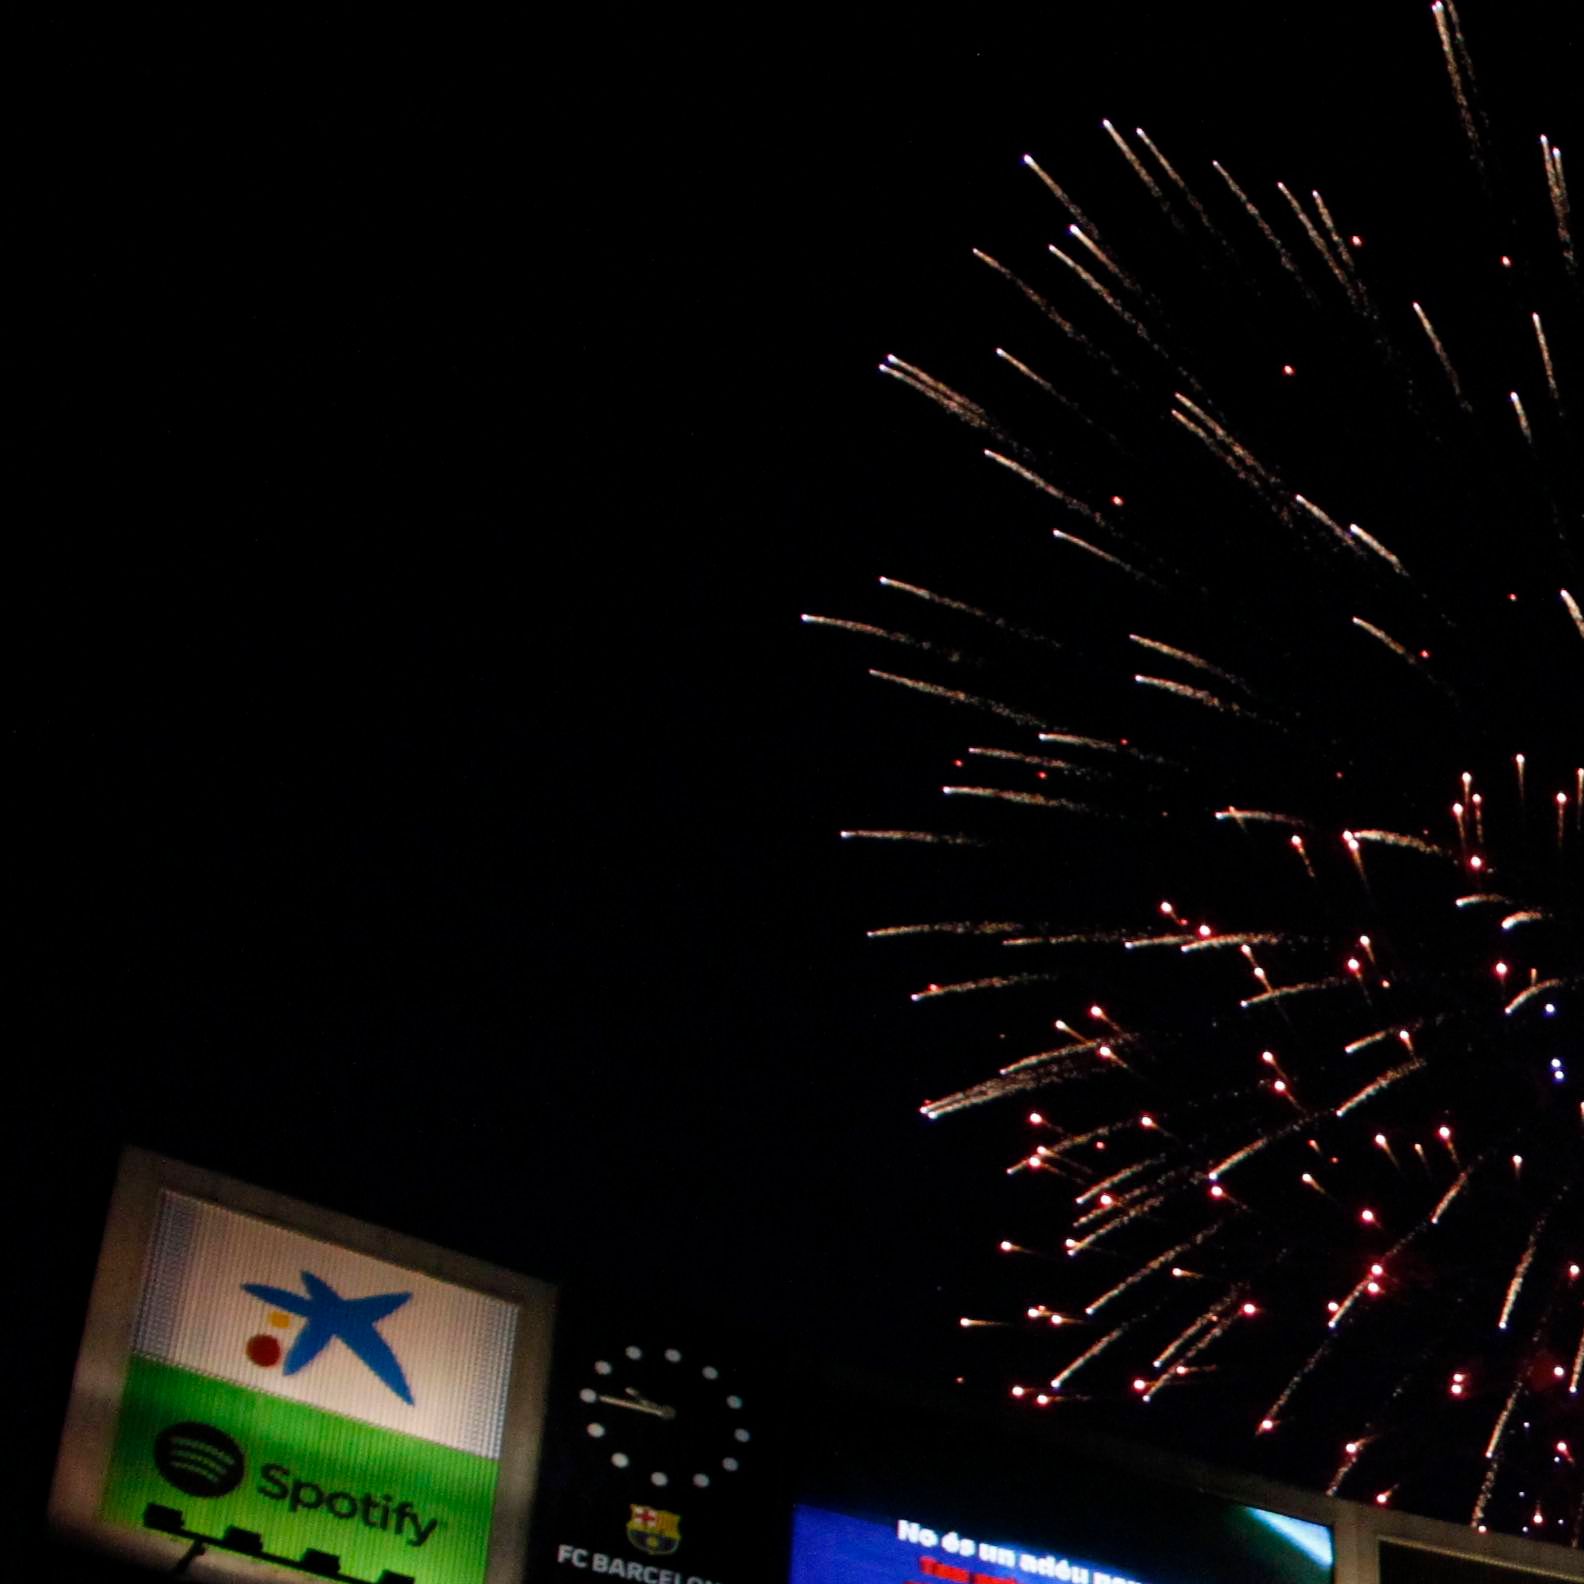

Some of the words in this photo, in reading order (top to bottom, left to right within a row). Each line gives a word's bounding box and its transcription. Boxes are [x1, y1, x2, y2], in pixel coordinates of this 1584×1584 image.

[257, 1462, 438, 1548] Spotify
[557, 1543, 588, 1571] FC
[898, 1519, 938, 1548] No
[941, 1531, 975, 1557] és
[978, 1542, 1016, 1568] un
